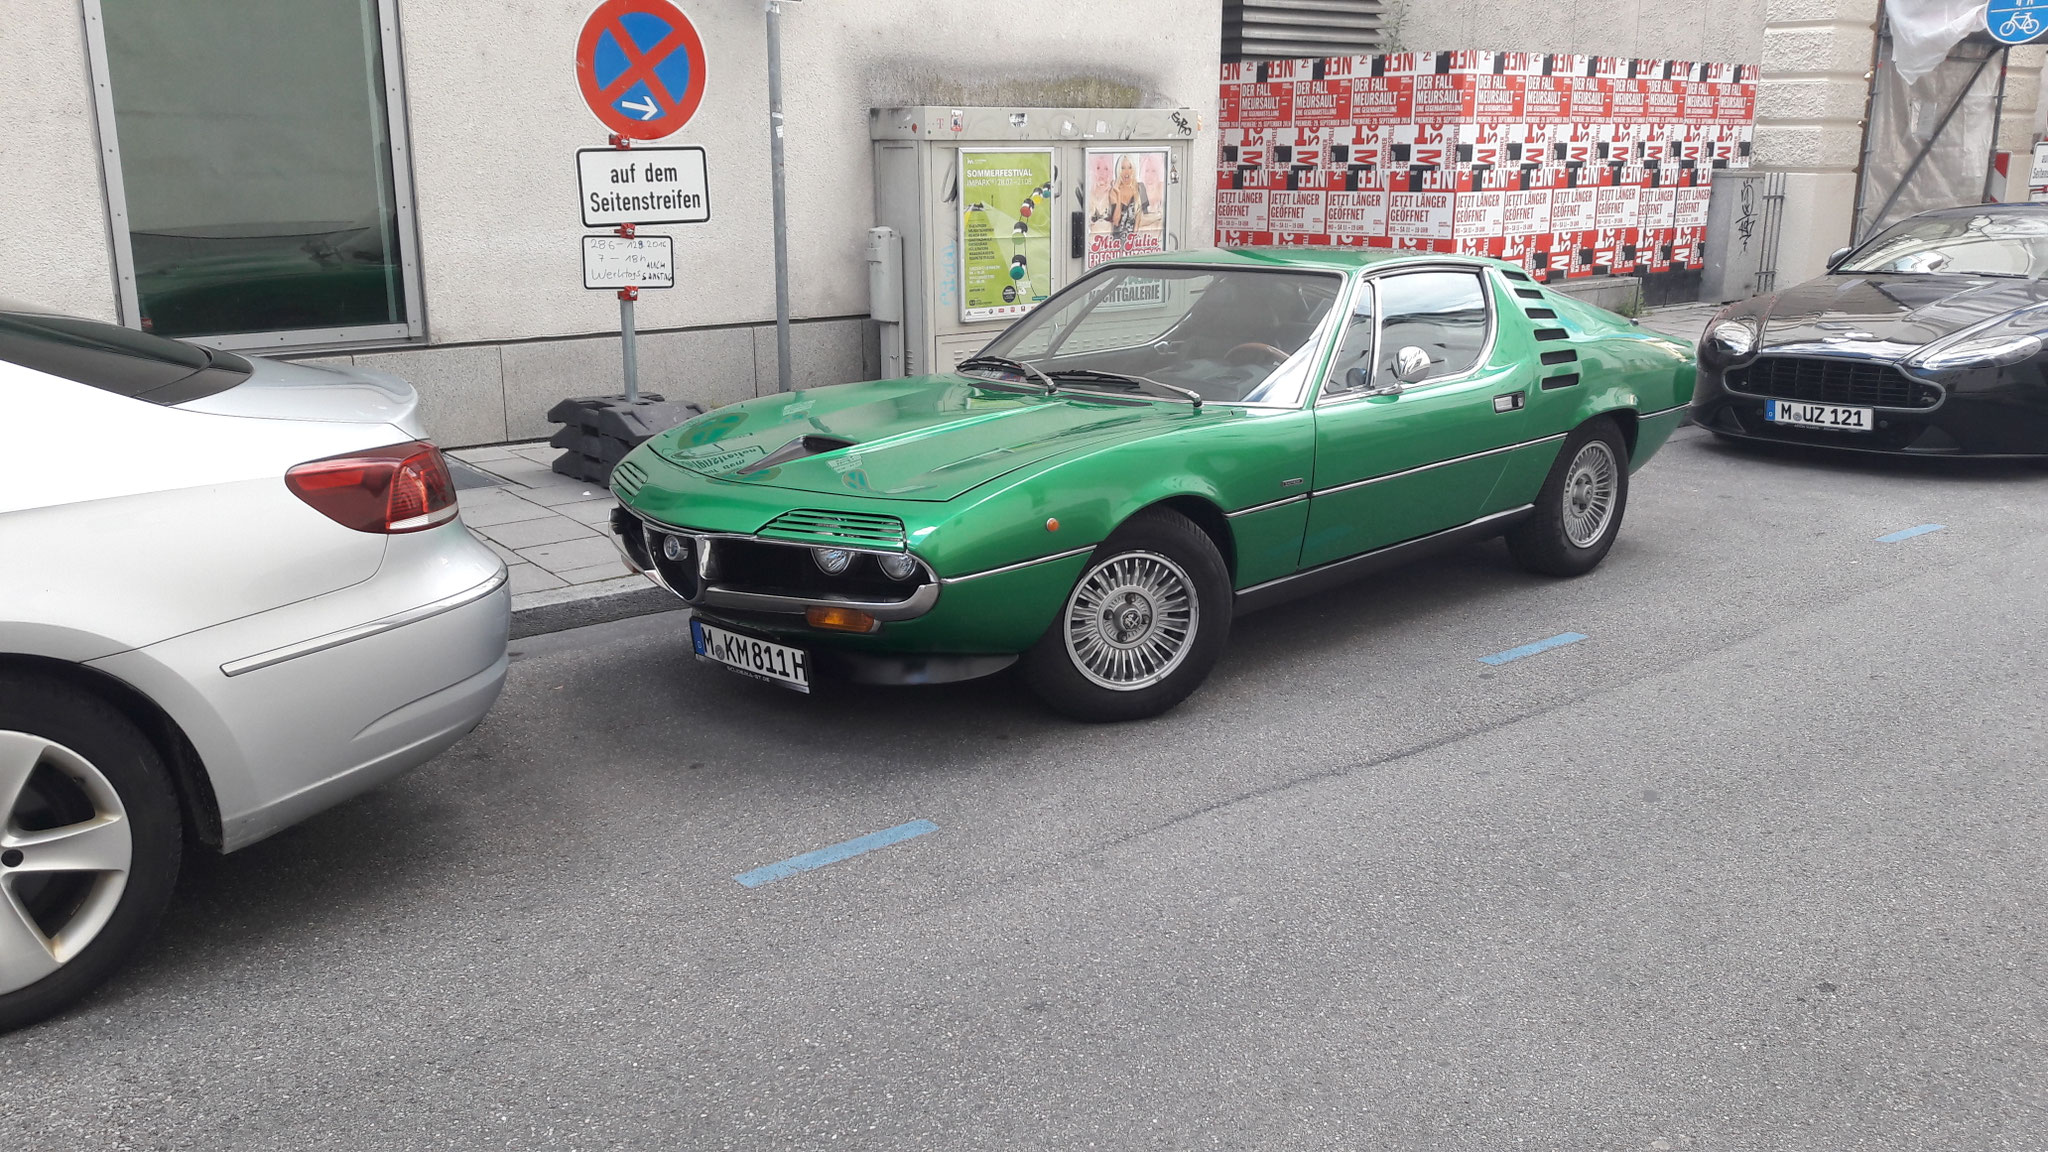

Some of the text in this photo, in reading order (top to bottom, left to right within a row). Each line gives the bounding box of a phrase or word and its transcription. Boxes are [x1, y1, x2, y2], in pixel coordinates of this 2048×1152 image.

[1297, 81, 1328, 94] DER FALL
[1355, 78, 1387, 91] DER FALL
[1418, 75, 1453, 89] DER FALL
[1480, 76, 1506, 89] DER FALL
[1529, 76, 1554, 90] DER FALL
[1574, 77, 1598, 90] DER FALL
[1242, 83, 1271, 96] DER FALL
[1242, 97, 1279, 109] MEURSAULT
[1296, 95, 1337, 108] MEURSAULT
[1354, 92, 1398, 105] MEURSAULT
[1417, 90, 1463, 103] MEURSAULT
[1479, 90, 1514, 104] MEURSAULT
[611, 162, 677, 183] auf dem
[967, 169, 1032, 177] SOMMERFESTIVAL
[590, 189, 700, 212] Seitenstreifen
[1219, 191, 1262, 203] JETZT LÄNGER
[1271, 192, 1319, 205] JETZT LÄNGER
[1329, 193, 1380, 206] JETZT LÄNGER
[1391, 193, 1446, 208] JETZT LÄNGER
[1457, 193, 1499, 208] JETZT LÄNGER
[1505, 192, 1547, 206] JETZT LÄNGER
[1553, 189, 1592, 204] JETZT LÄNGER
[1599, 188, 1635, 200] JETZT LÄNGER
[1219, 204, 1249, 216] GEÖFFNET
[1271, 205, 1305, 218] GEÖFFNET
[1328, 206, 1364, 220] GEÖFFNET
[1505, 206, 1534, 220] GEÖFFNET
[1553, 204, 1580, 217] GEÖFFNET
[1598, 202, 1624, 214] GEÖFFNET
[1391, 208, 1429, 222] GEÖFFNET
[1457, 208, 1486, 222] GEÖFFNET
[647, 240, 666, 248] 2016
[1092, 234, 1158, 252] Mia Julia
[598, 254, 604, 262] 7
[1088, 284, 1160, 302] NHTGALERIE
[1781, 403, 1792, 420] M
[1803, 406, 1825, 423] UZ
[1830, 408, 1863, 426] 121
[702, 626, 714, 655] M
